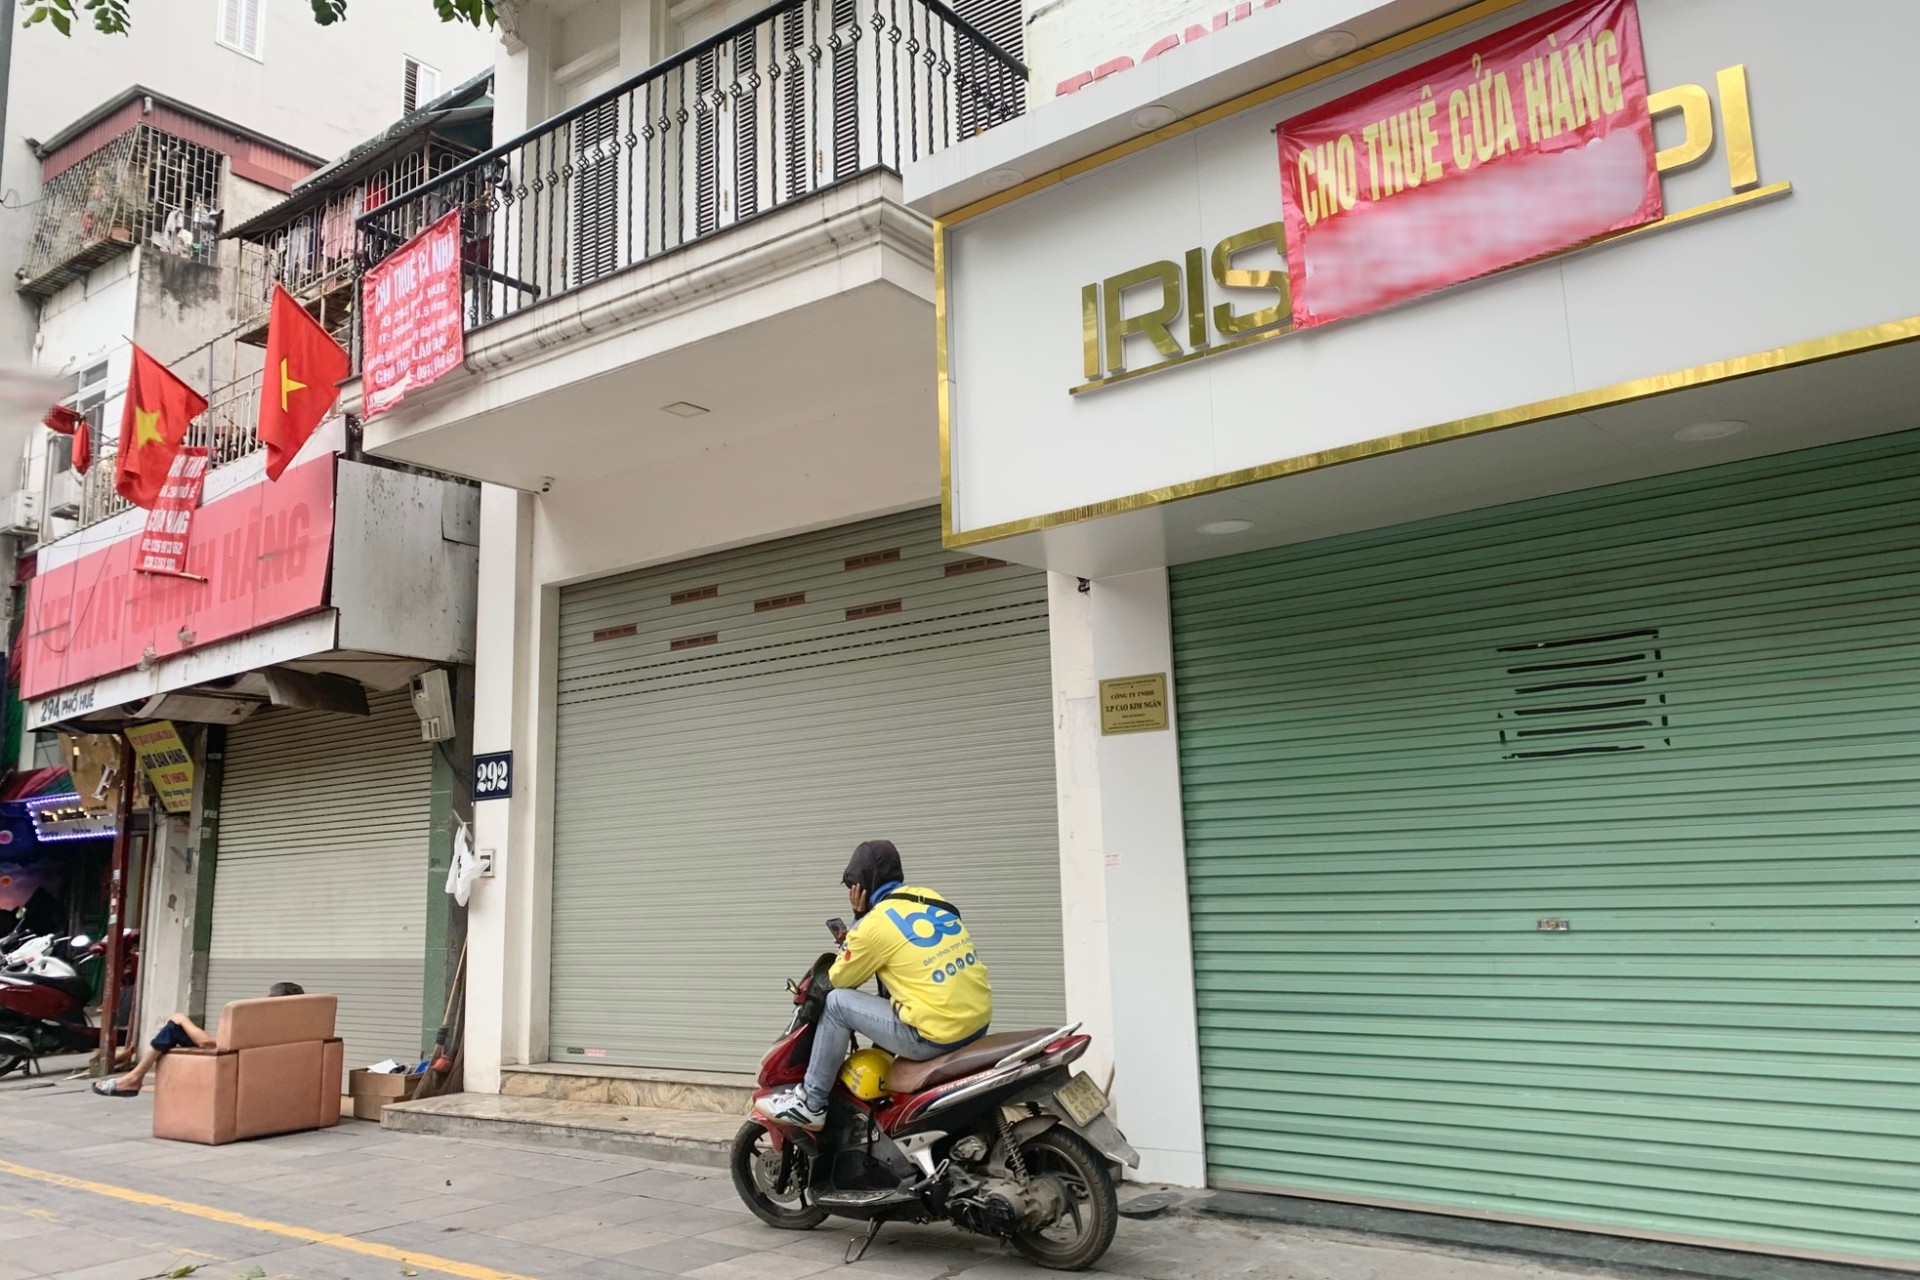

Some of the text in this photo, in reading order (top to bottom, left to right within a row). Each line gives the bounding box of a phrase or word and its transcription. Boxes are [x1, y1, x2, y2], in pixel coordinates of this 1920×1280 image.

[1297, 134, 1358, 227] CHO
[1362, 85, 1443, 201] THUÊ
[1449, 53, 1520, 170] CỬA
[1522, 29, 1625, 144] HÀNG
[1082, 222, 1291, 379] IRIS
[41, 695, 60, 723] 294
[1111, 691, 1127, 700] CÔNG
[1115, 703, 1129, 712] CAO
[1129, 702, 1143, 711] KIM
[476, 760, 509, 793] 292
[884, 904, 962, 949] be
